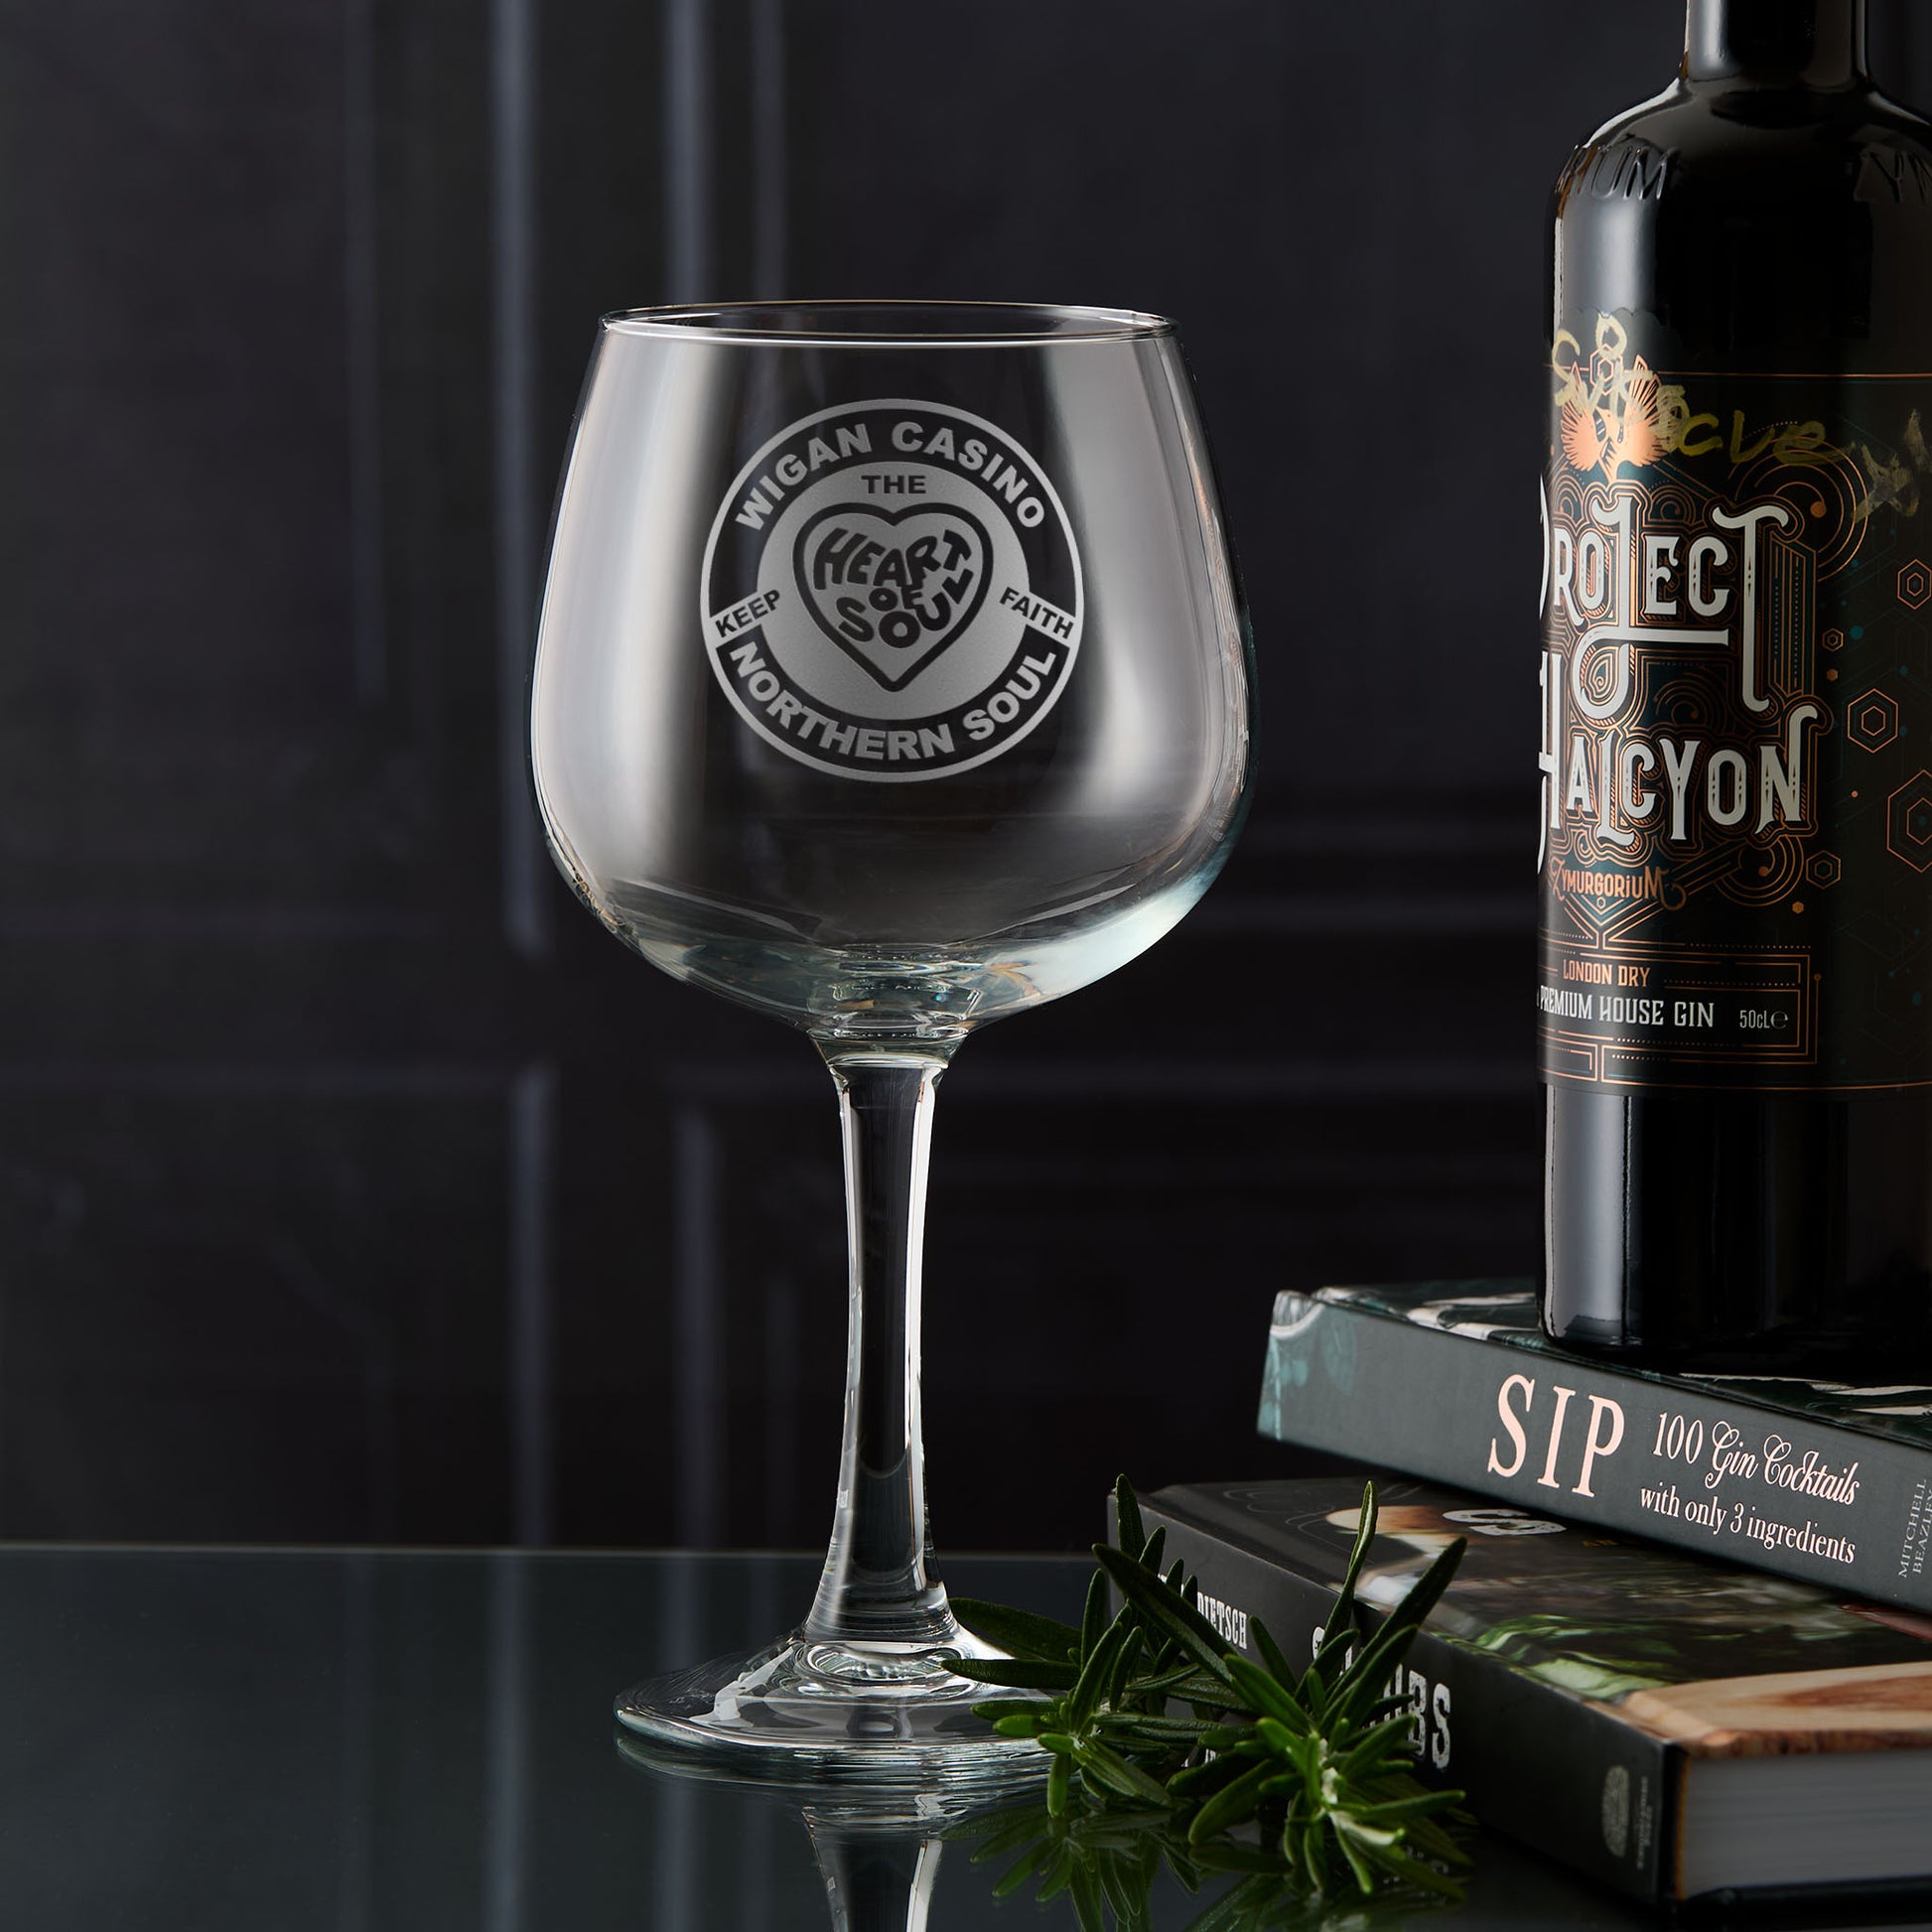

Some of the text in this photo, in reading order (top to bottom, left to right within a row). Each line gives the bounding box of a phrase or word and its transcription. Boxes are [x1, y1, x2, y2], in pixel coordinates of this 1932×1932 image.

[735, 421, 1045, 531] WIGAN CASINO
[861, 475, 927, 494] THE
[813, 527, 972, 591] HEART
[714, 589, 781, 638] KEEP
[835, 568, 975, 649] SOUL
[869, 586, 925, 613] OF
[999, 586, 1074, 640] FAITH
[730, 641, 1057, 760] NORTHERN SOUL
[1540, 984, 1593, 1021] PREMIUM
[1598, 995, 1665, 1027] HOUSE
[1674, 1001, 1716, 1029] GIN
[1563, 958, 1651, 988] LONDON DRY
[1487, 1373, 1625, 1497] SIP
[1652, 1412, 1862, 1506] 100 Gin Cocktails
[1640, 1481, 1858, 1565] with only 3 ingredients
[1898, 1478, 1927, 1579] MITCHELL
